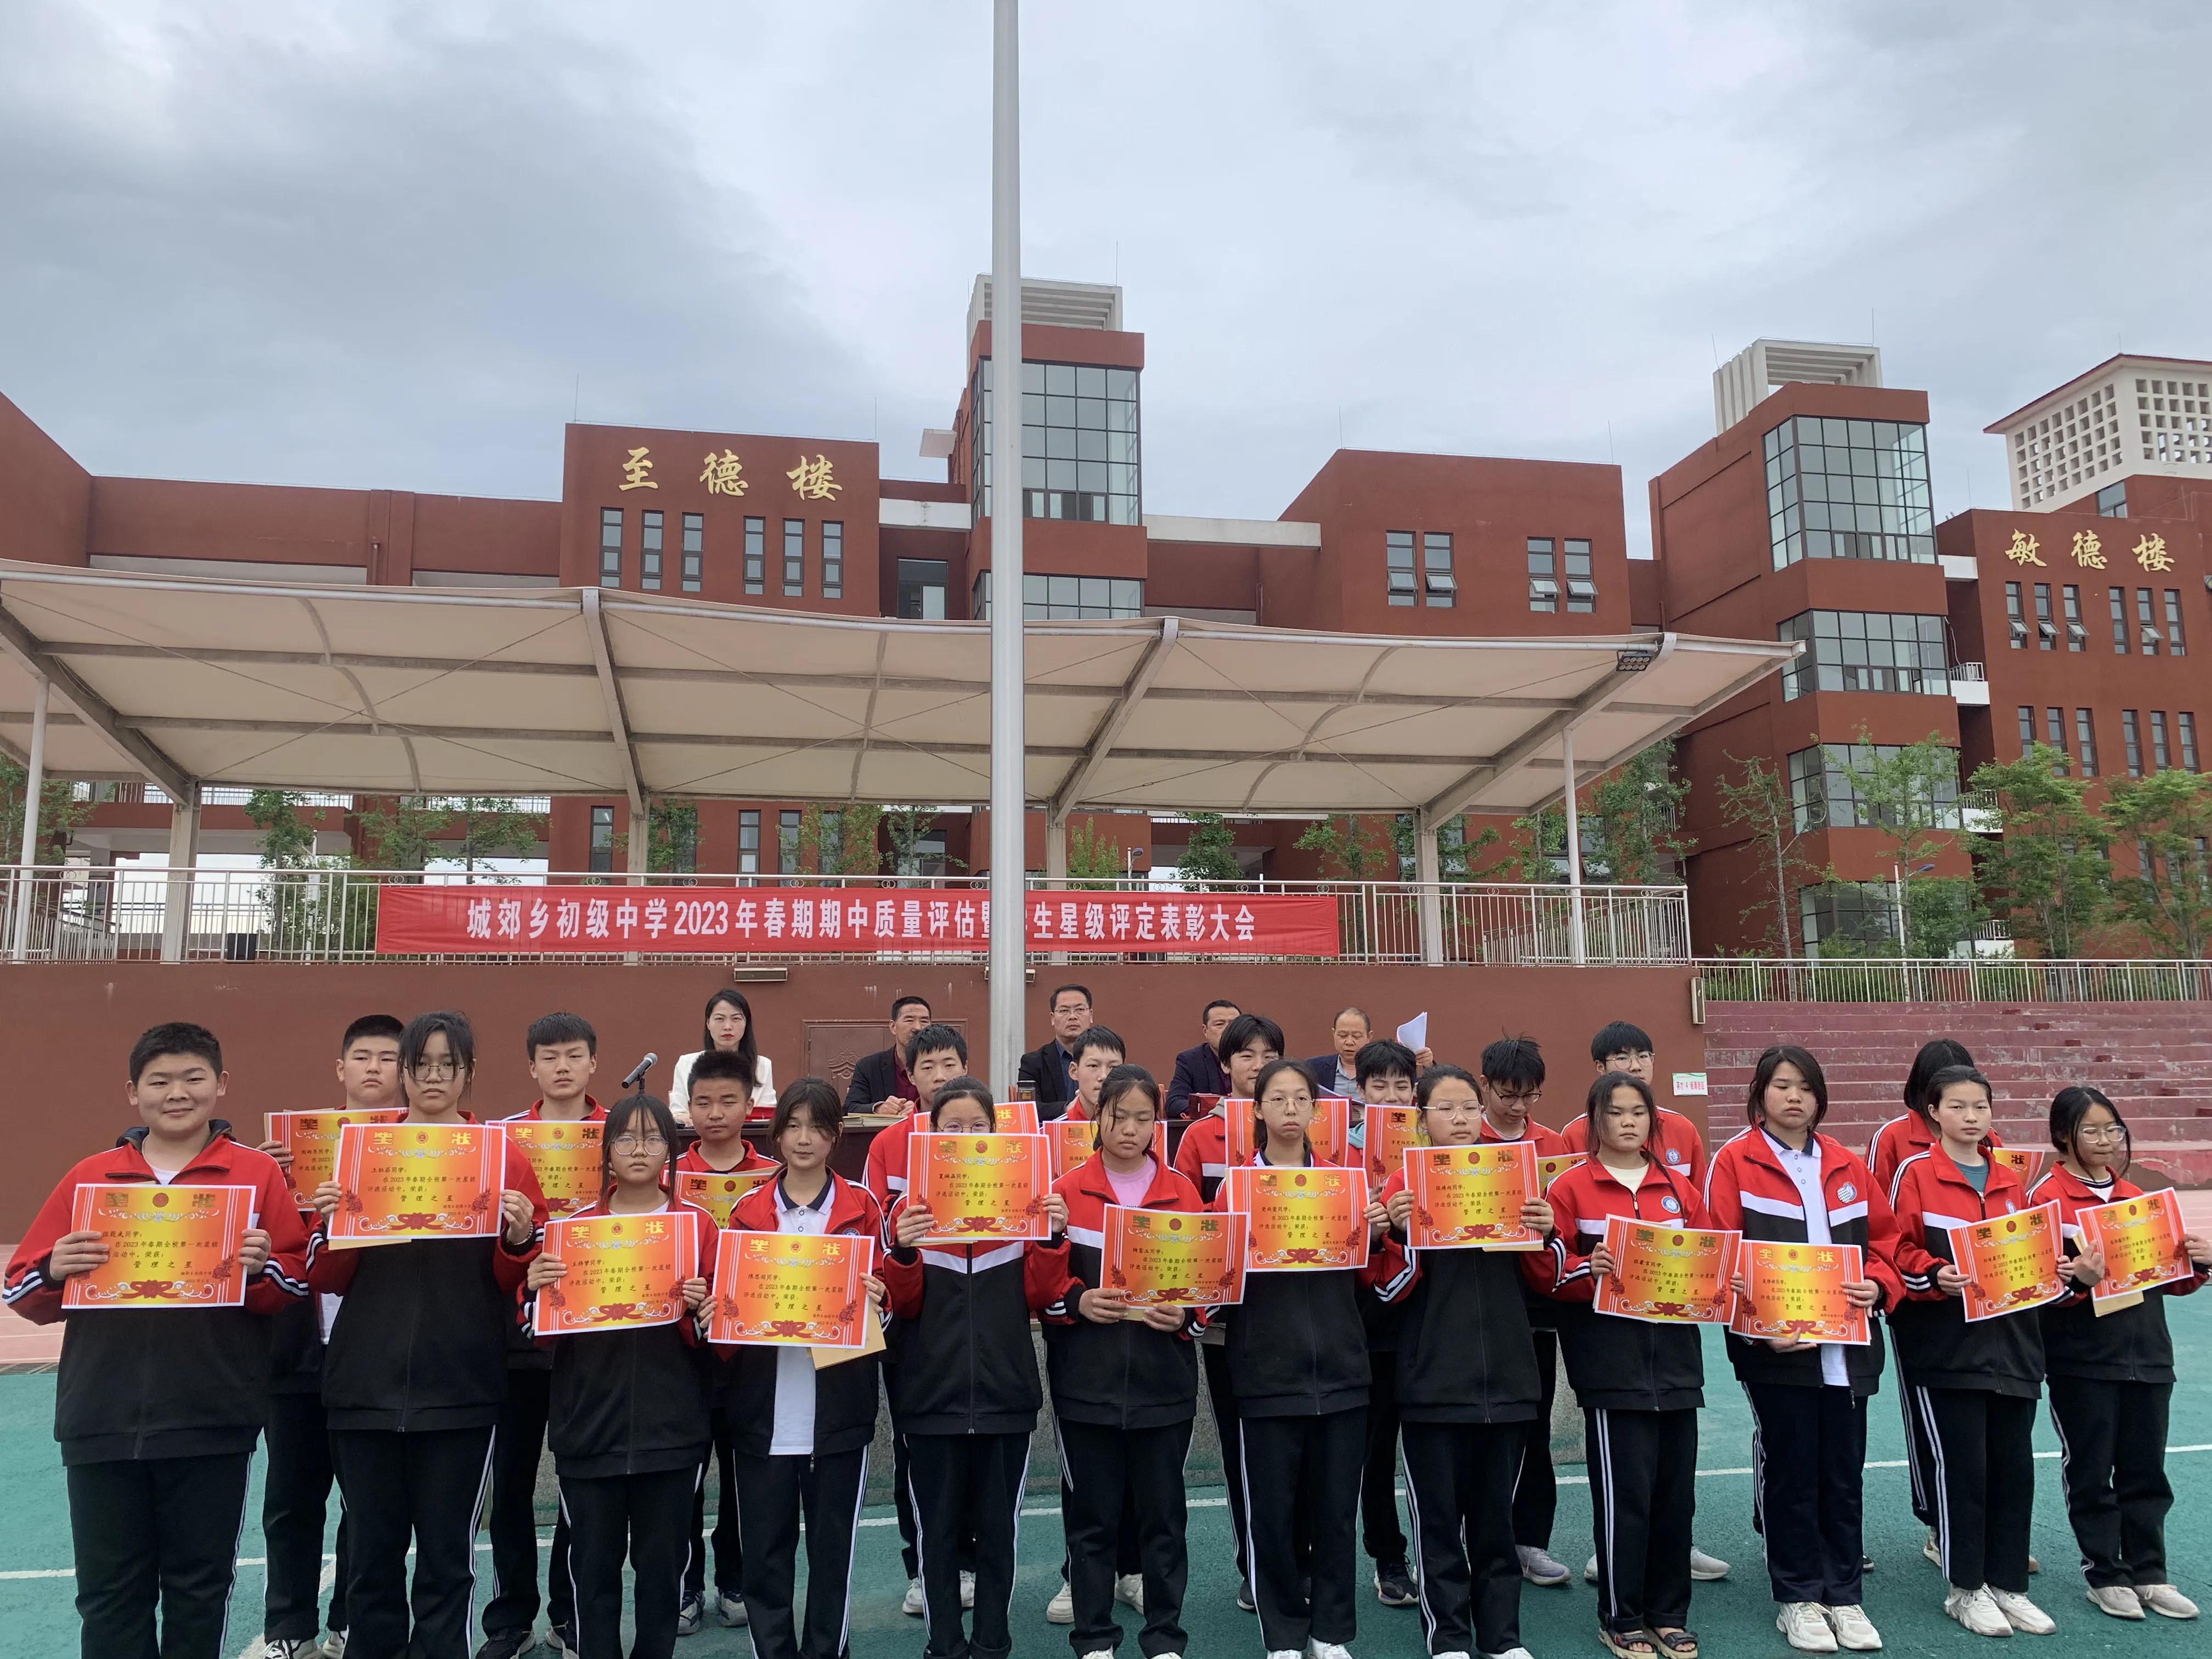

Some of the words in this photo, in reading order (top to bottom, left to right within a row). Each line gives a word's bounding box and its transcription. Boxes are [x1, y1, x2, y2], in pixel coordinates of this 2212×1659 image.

[618, 447, 843, 501] 至德楼
[2005, 528, 2175, 572] 敏德楼
[467, 897, 1256, 942] 城郊乡初级中学2023年春期期中质量评估生星级评定表彰大会
[2011, 1155, 2025, 1164] 状
